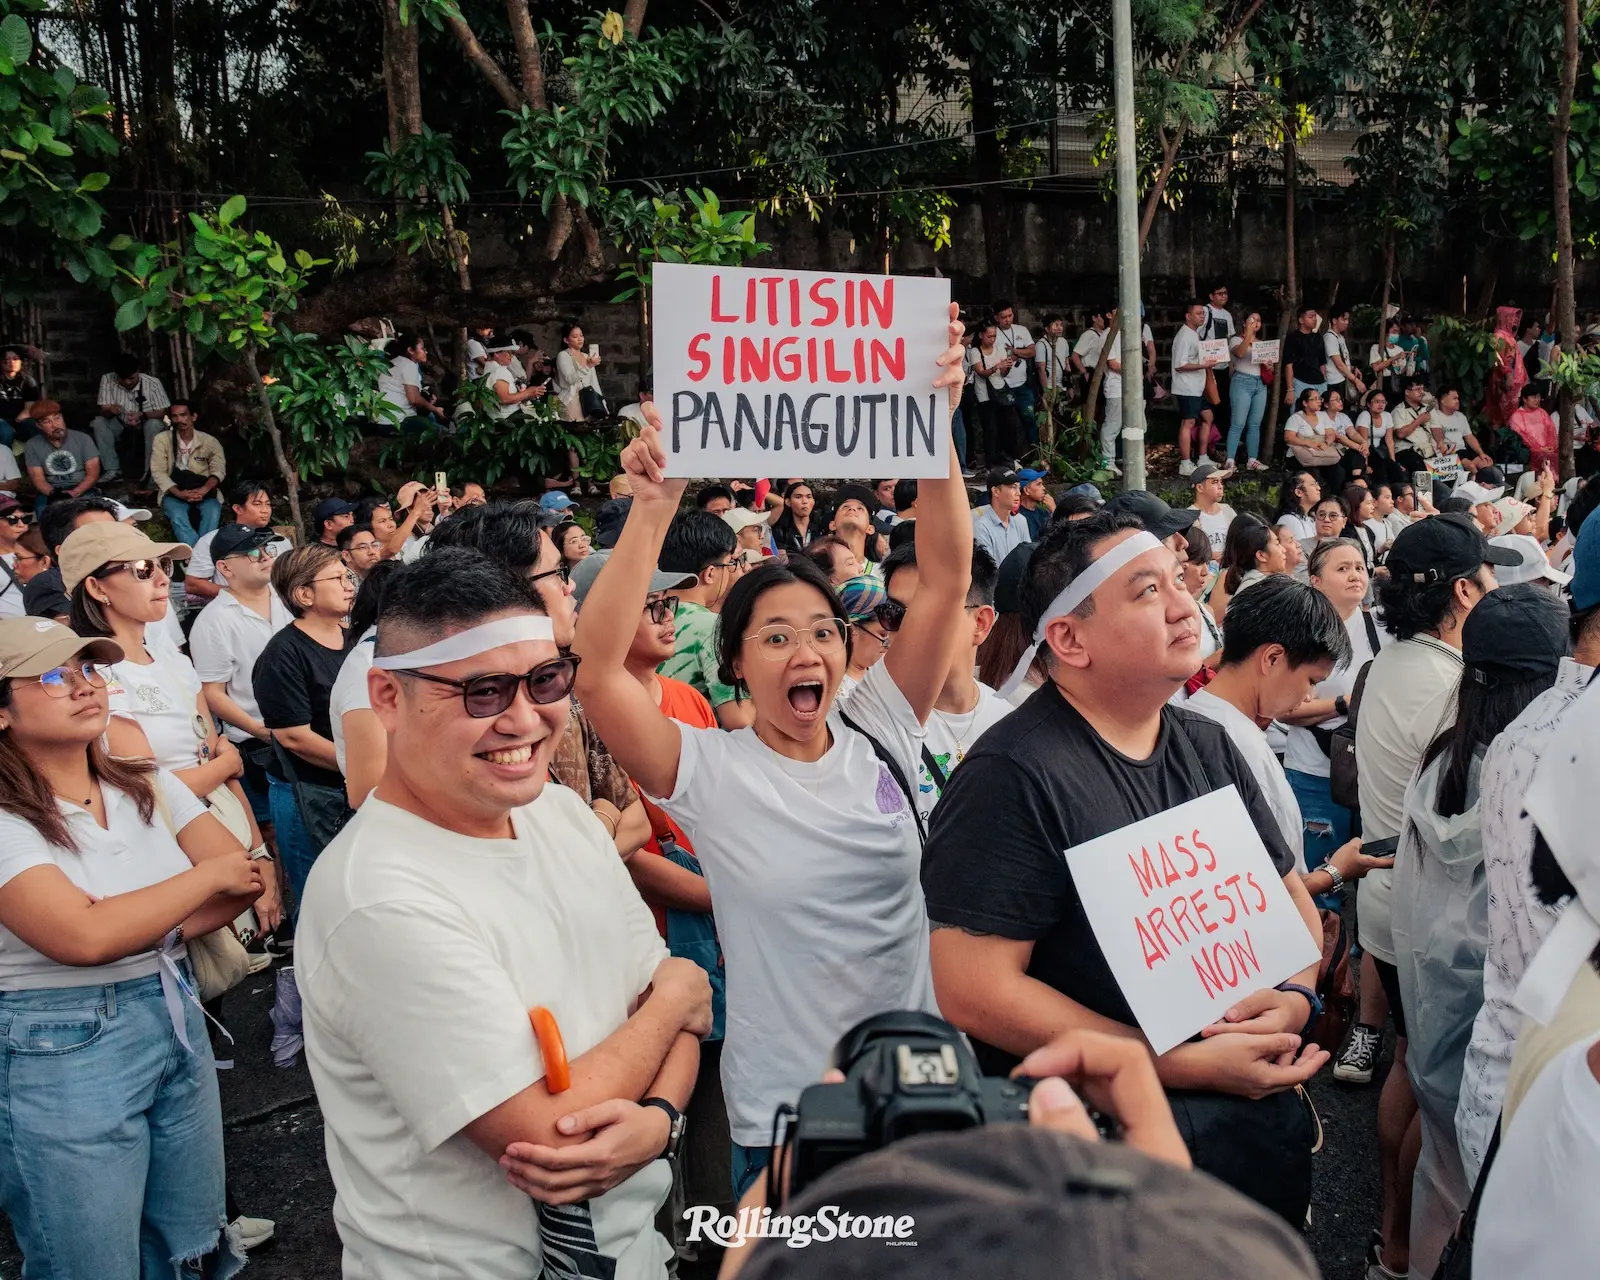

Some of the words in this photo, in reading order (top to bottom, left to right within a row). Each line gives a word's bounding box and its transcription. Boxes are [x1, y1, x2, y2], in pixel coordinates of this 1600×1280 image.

[710, 275, 894, 330] LITISIN
[687, 332, 906, 385] SINGILIN
[673, 391, 935, 459] PANAGUTIN
[1129, 830, 1216, 897] MASS
[1135, 872, 1266, 969] ARRESTS
[1192, 930, 1260, 999] NOW
